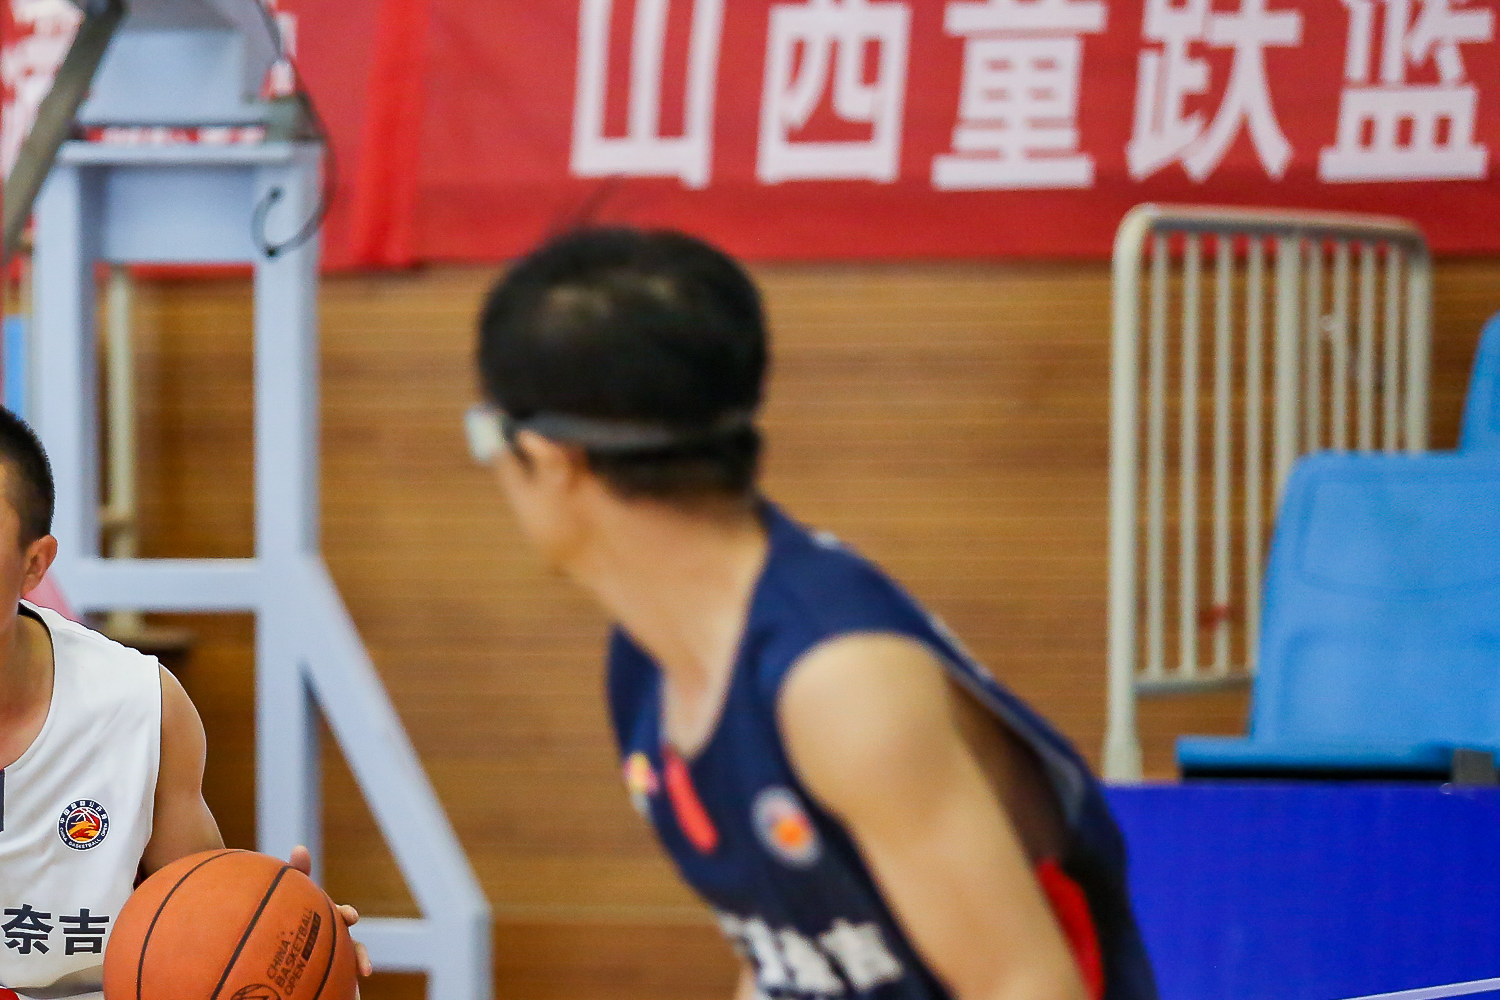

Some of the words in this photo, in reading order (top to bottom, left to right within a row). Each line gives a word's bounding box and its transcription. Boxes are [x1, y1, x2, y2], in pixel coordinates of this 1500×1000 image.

[266, 939, 291, 980] CHINA
[275, 906, 313, 988] BASKETBALL
[284, 957, 307, 996] OPEN
